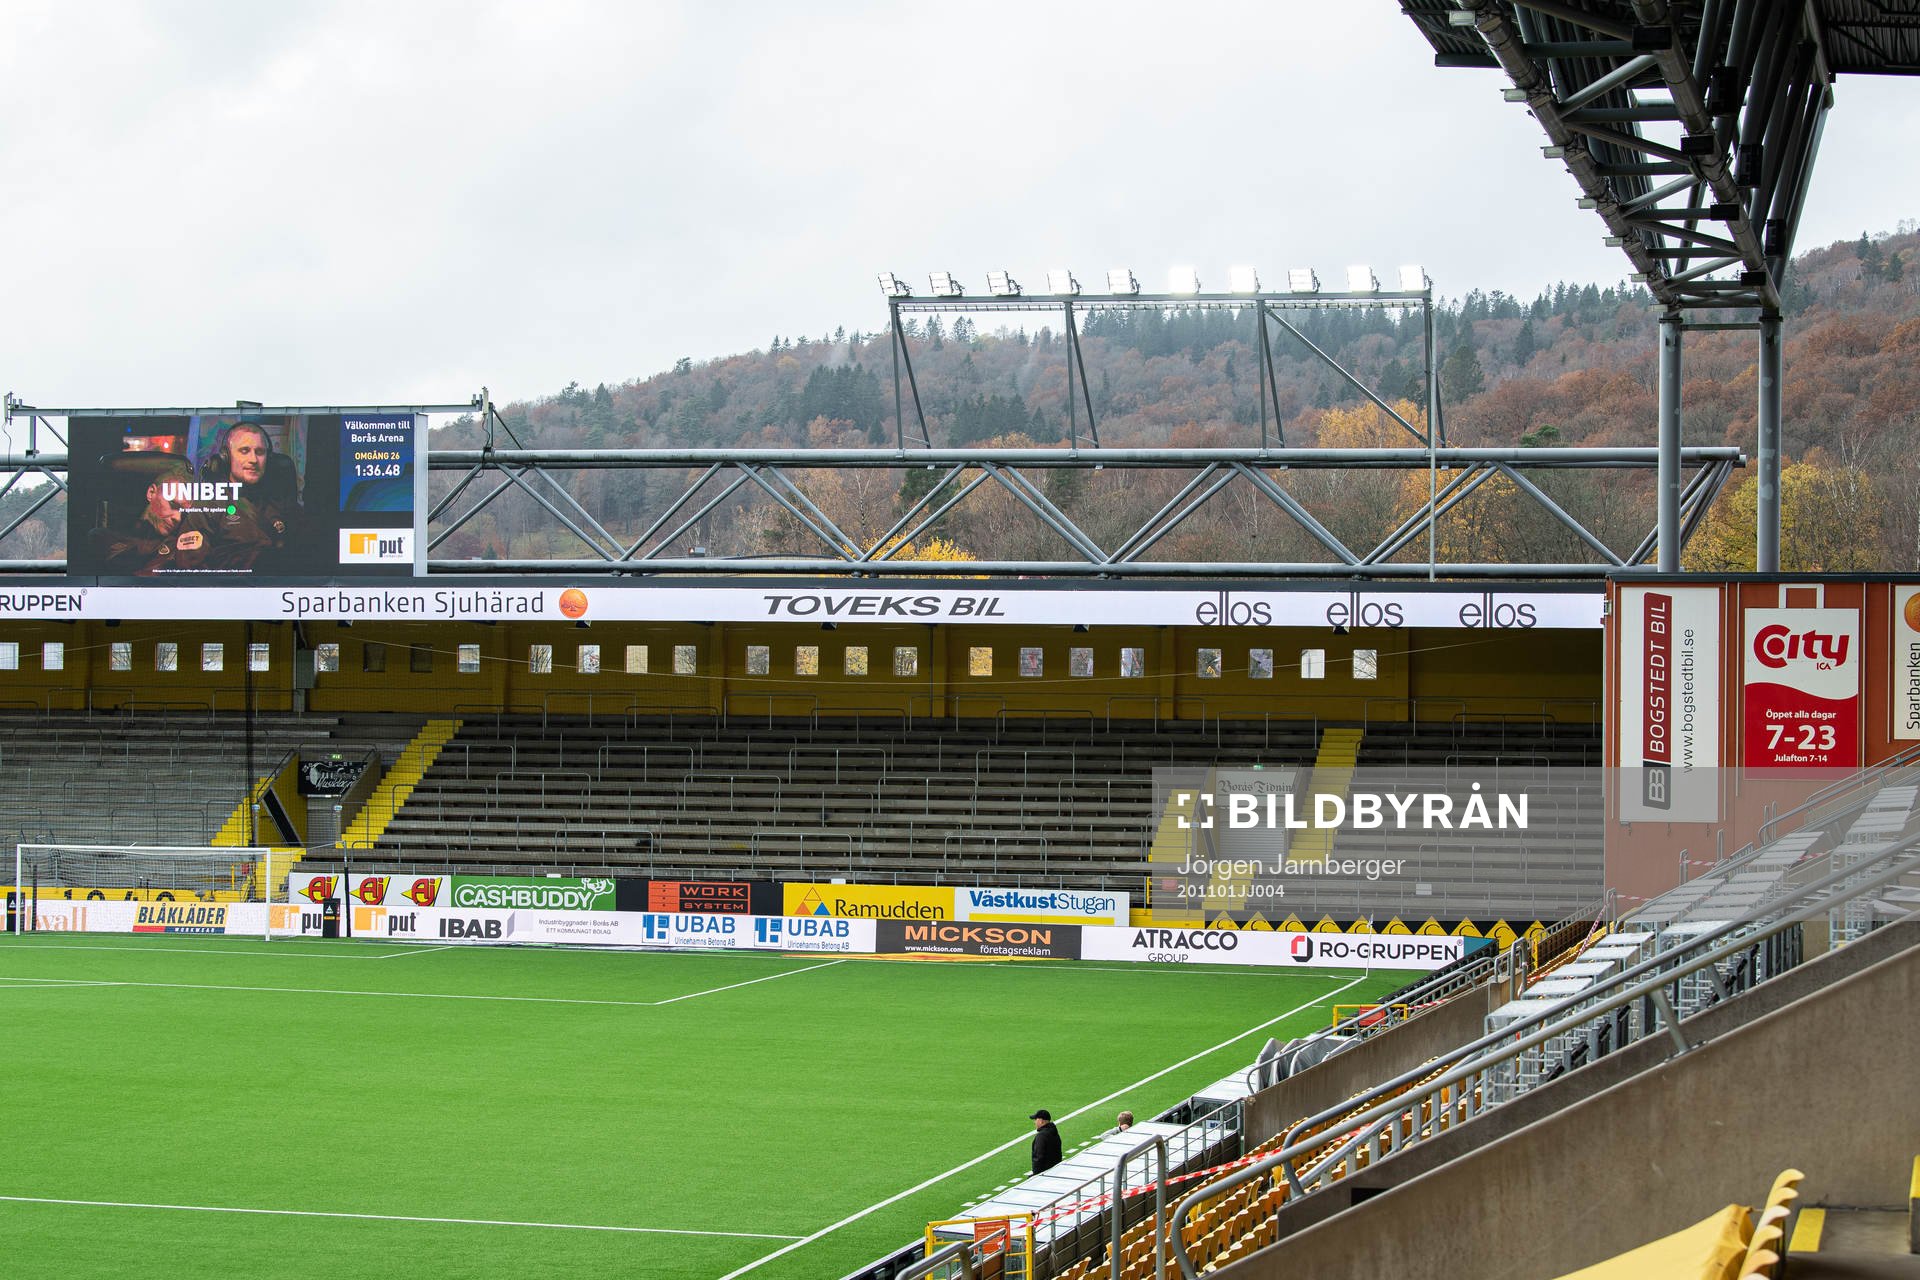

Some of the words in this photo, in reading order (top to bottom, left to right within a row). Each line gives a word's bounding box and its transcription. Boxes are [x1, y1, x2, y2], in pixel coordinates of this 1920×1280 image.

[345, 421, 396, 430] Välkommen
[398, 421, 410, 429] till
[351, 433, 377, 443] Borås
[380, 434, 404, 442] Arena
[355, 450, 389, 460] OMGÅNG
[391, 452, 400, 460] 26
[355, 464, 400, 476] 1:36.48
[162, 483, 243, 500] UNIBET
[282, 592, 425, 617] Sparbanken
[435, 592, 544, 618] Sjuhärad
[763, 596, 941, 615] TOVEKS
[949, 598, 1005, 616] BIL
[1196, 591, 1272, 625] ellos
[1326, 592, 1404, 627] ellos
[1459, 593, 1537, 627] ellos
[1650, 602, 1666, 635] BIL
[1753, 624, 1850, 669] City
[1817, 663, 1832, 671] ICA
[1650, 640, 1665, 753] BOGSTEDT
[1681, 628, 1696, 774] www.bogstedtbil.se
[1766, 709, 1793, 720] Öppet
[1811, 711, 1837, 720] dagar
[1766, 724, 1836, 750] 7-23
[459, 889, 591, 908] CASHBUDDY
[683, 886, 745, 896] WORK
[138, 902, 226, 924] BLÅKLÄDER
[684, 902, 744, 910] SYSTEM
[835, 899, 944, 918] Ramudden
[439, 918, 502, 938] IBAB
[676, 915, 735, 933] UBAB
[788, 919, 849, 937] UBAB
[788, 940, 820, 949] Ulricehamns
[821, 942, 840, 951] Betong
[841, 942, 850, 950] AB
[1132, 929, 1238, 950] ATRACCO
[905, 945, 964, 953] www.mickson.com
[980, 945, 1051, 956] företagsreklam
[1147, 952, 1189, 963] GROUP
[1320, 941, 1458, 960] RO-GRUPPEN
